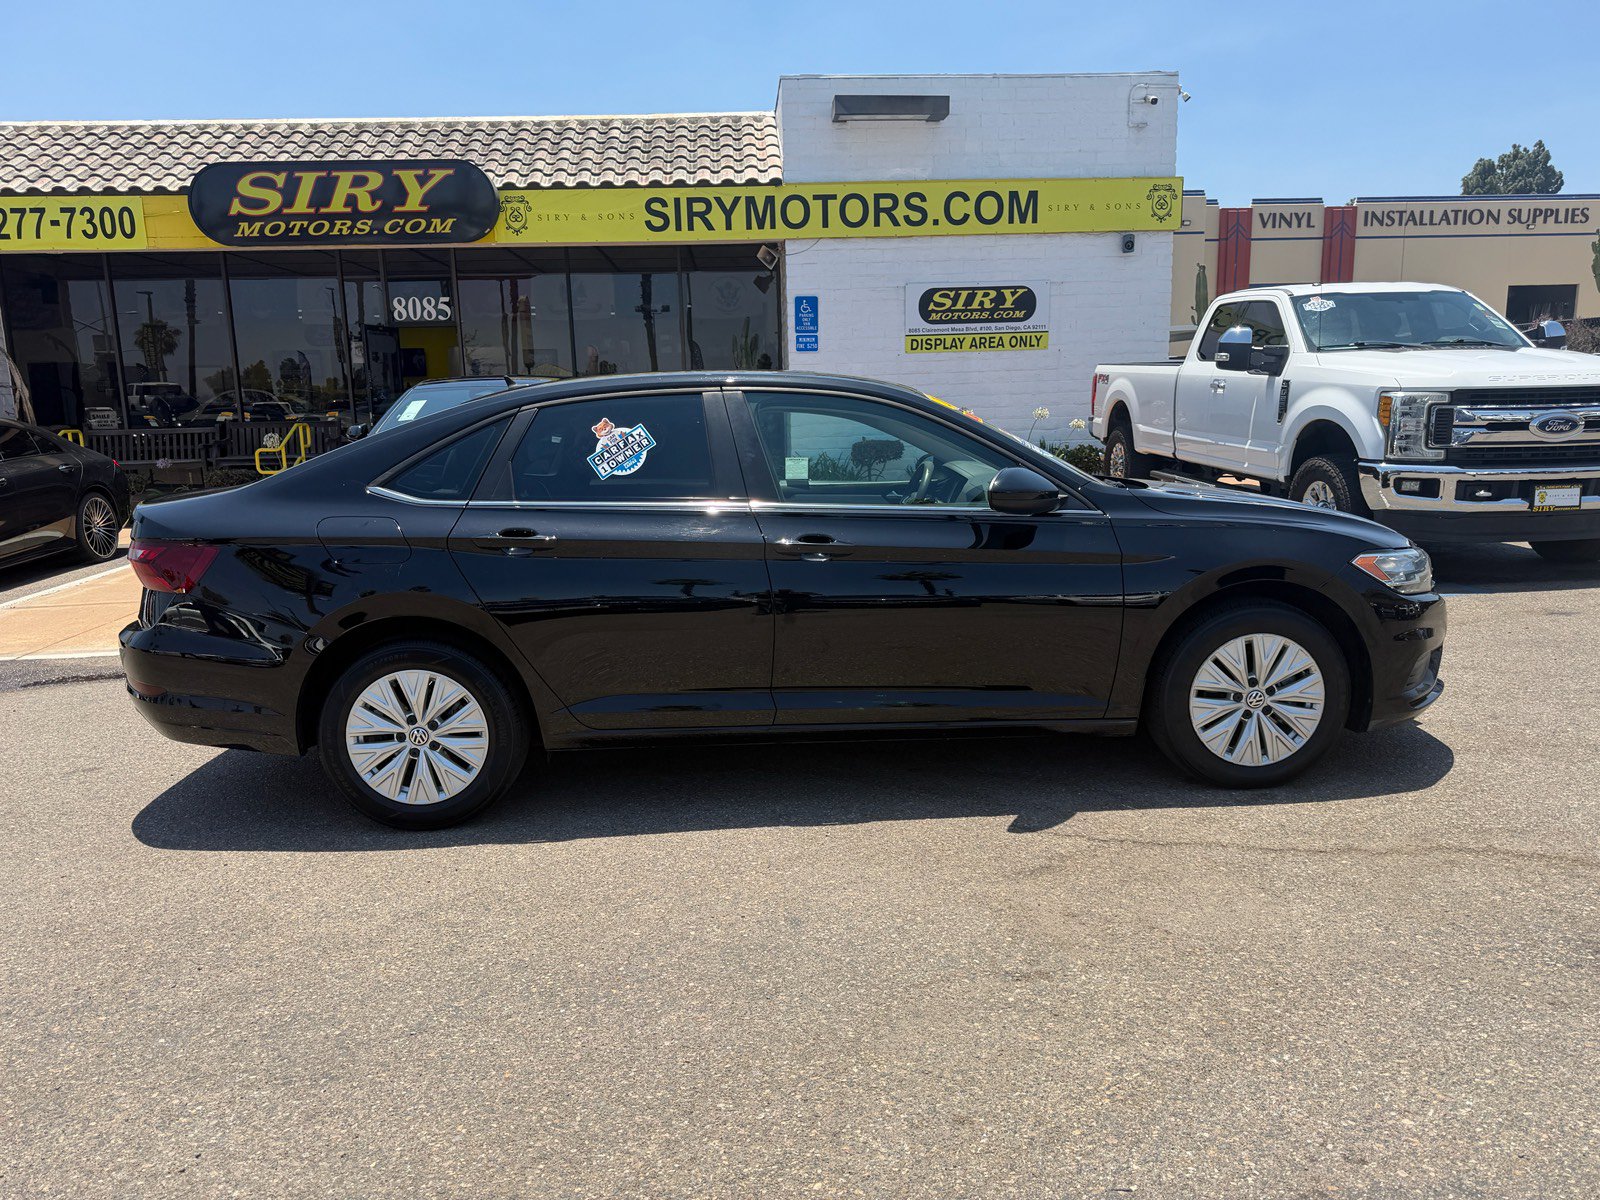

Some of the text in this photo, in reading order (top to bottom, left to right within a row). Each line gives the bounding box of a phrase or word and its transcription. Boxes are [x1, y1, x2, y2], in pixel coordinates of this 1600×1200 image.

[228, 168, 456, 217] SIRY
[537, 212, 635, 222] SIRY & SONS
[644, 189, 1039, 233] SIRYMOTORS.COM
[1047, 202, 1141, 212] SIRY & SONS
[1363, 207, 1590, 227] INSTALLATION SUPPLIES
[0, 206, 136, 239] 277-7300
[233, 218, 457, 238] MOTORS.COM
[1258, 211, 1316, 229] VINYL
[392, 296, 452, 321] 8085
[927, 288, 1028, 311] SIRY
[928, 310, 1027, 321] MOTORS.COM
[910, 335, 1043, 351] DISPLAY AREA ONLY
[1545, 419, 1572, 432] Ford
[594, 431, 644, 465] CARFAX
